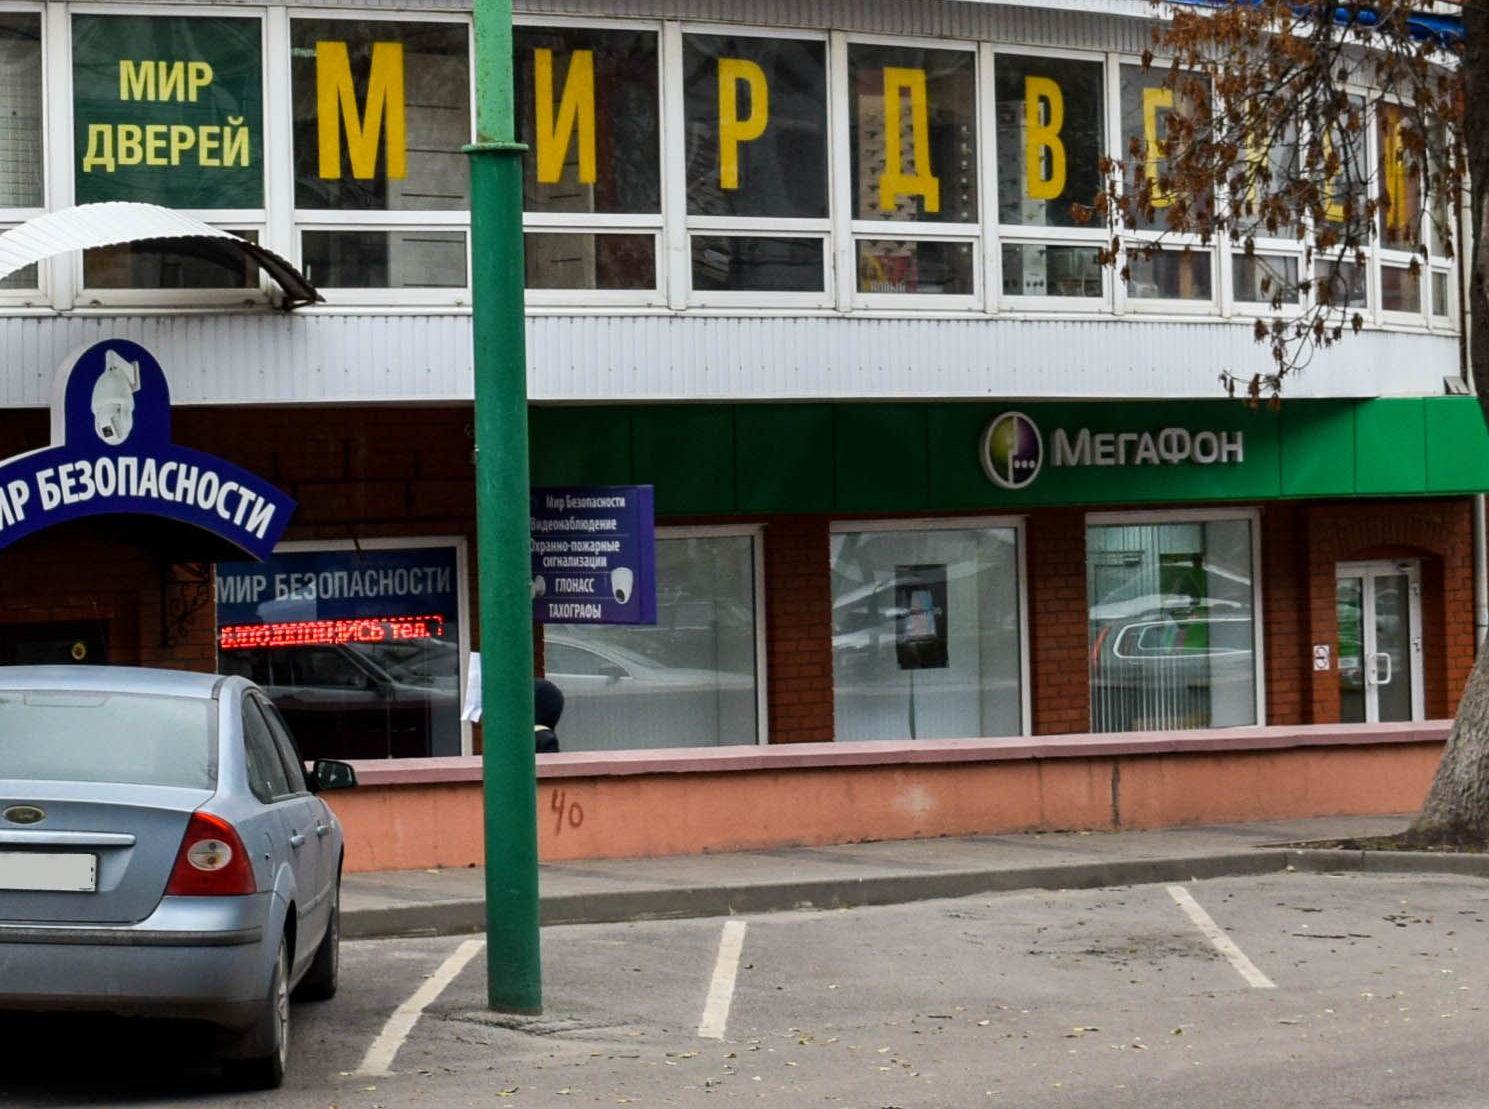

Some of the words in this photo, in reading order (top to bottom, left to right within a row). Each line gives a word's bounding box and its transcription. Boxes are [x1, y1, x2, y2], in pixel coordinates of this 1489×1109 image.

[120, 59, 215, 103] МИР
[83, 116, 250, 173] ДВЕРЕЙ
[36, 456, 276, 539] БЕЗОПАСНОСТИ
[546, 495, 565, 511] Мир
[566, 495, 626, 509] Безопасности
[543, 556, 607, 570] сигнализации
[217, 575, 266, 603] МИР
[275, 567, 450, 601] БЕЗОПАСНОСТИ
[555, 578, 595, 593] ГЛОНАСС
[549, 604, 602, 619] ТАХОГРАФЫ
